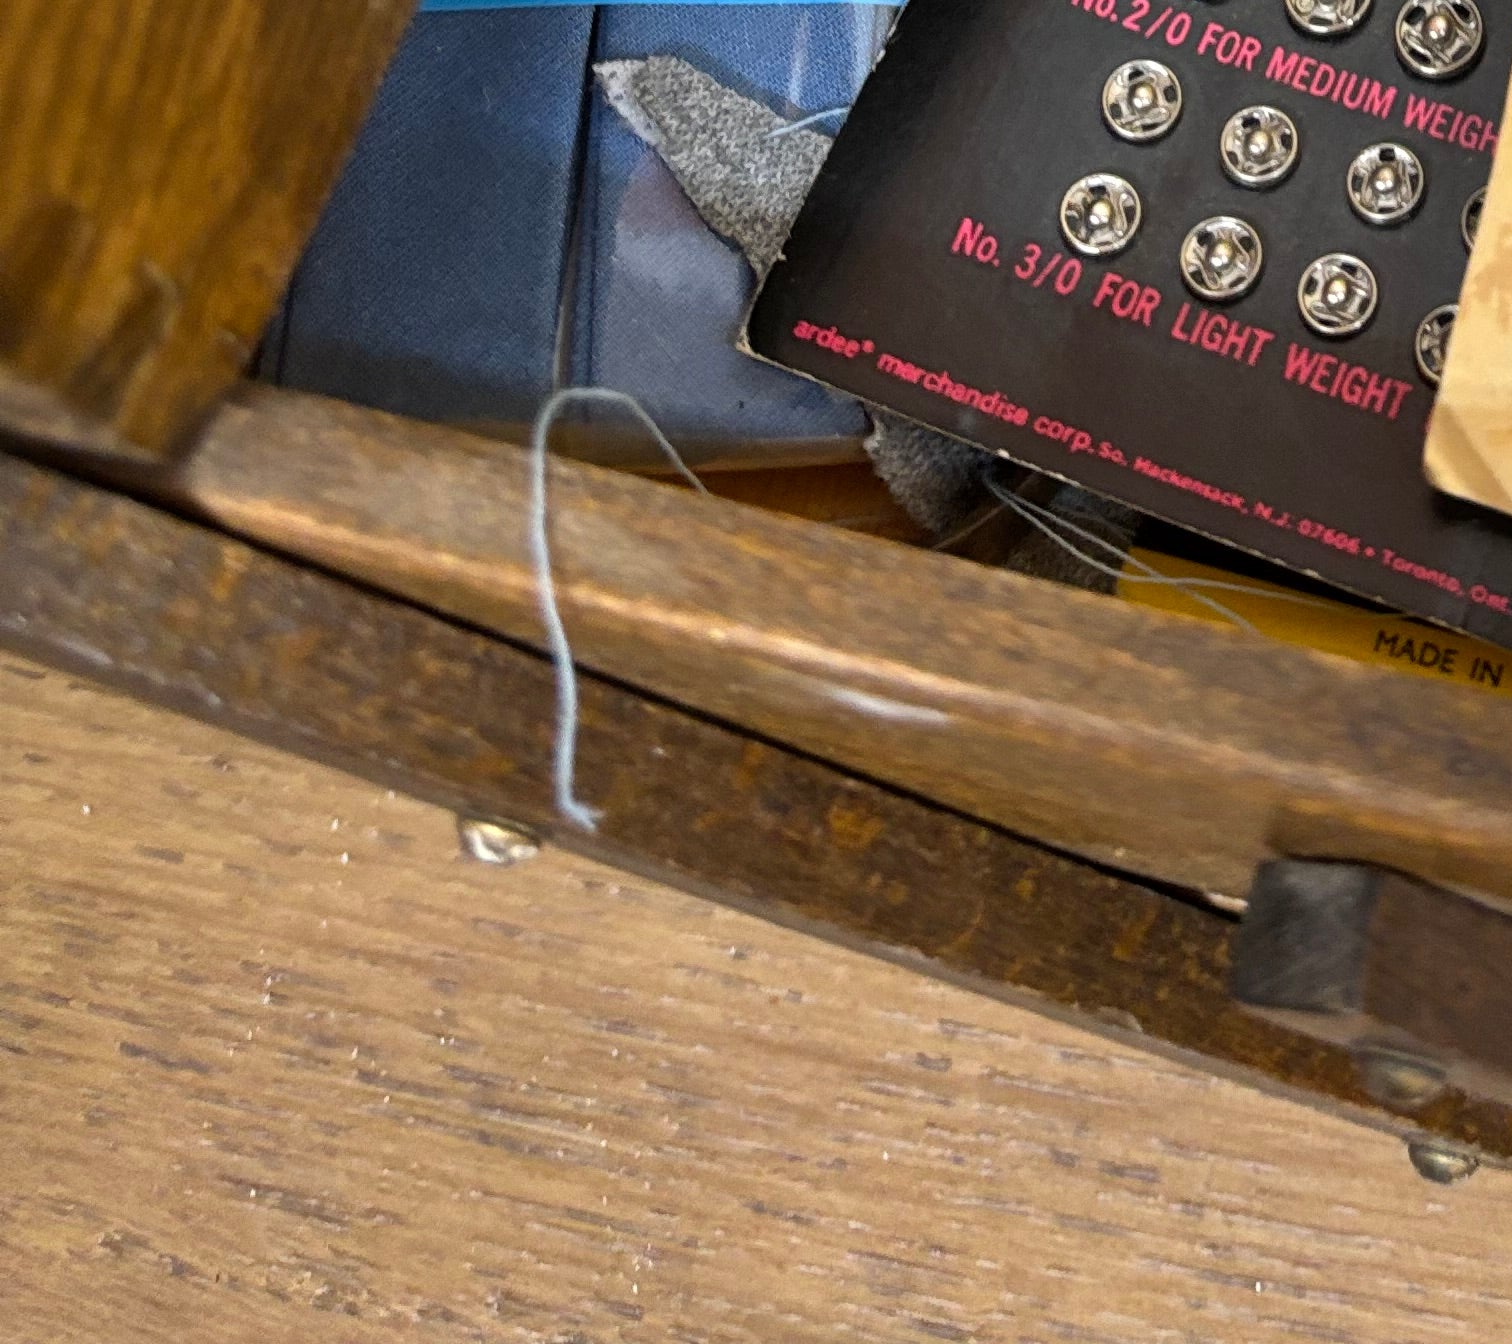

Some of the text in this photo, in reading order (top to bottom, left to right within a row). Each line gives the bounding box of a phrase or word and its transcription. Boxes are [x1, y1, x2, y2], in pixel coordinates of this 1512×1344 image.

[1198, 21, 1263, 72] FOR
[1265, 46, 1397, 115] MEDIUM
[951, 218, 1415, 422] No. 3/0 FOR LIGHT WEIGHT
[876, 351, 1031, 428] merchandise
[1031, 414, 1098, 457] corp.
[1373, 628, 1458, 675] MADE
[1469, 654, 1507, 689] IN
